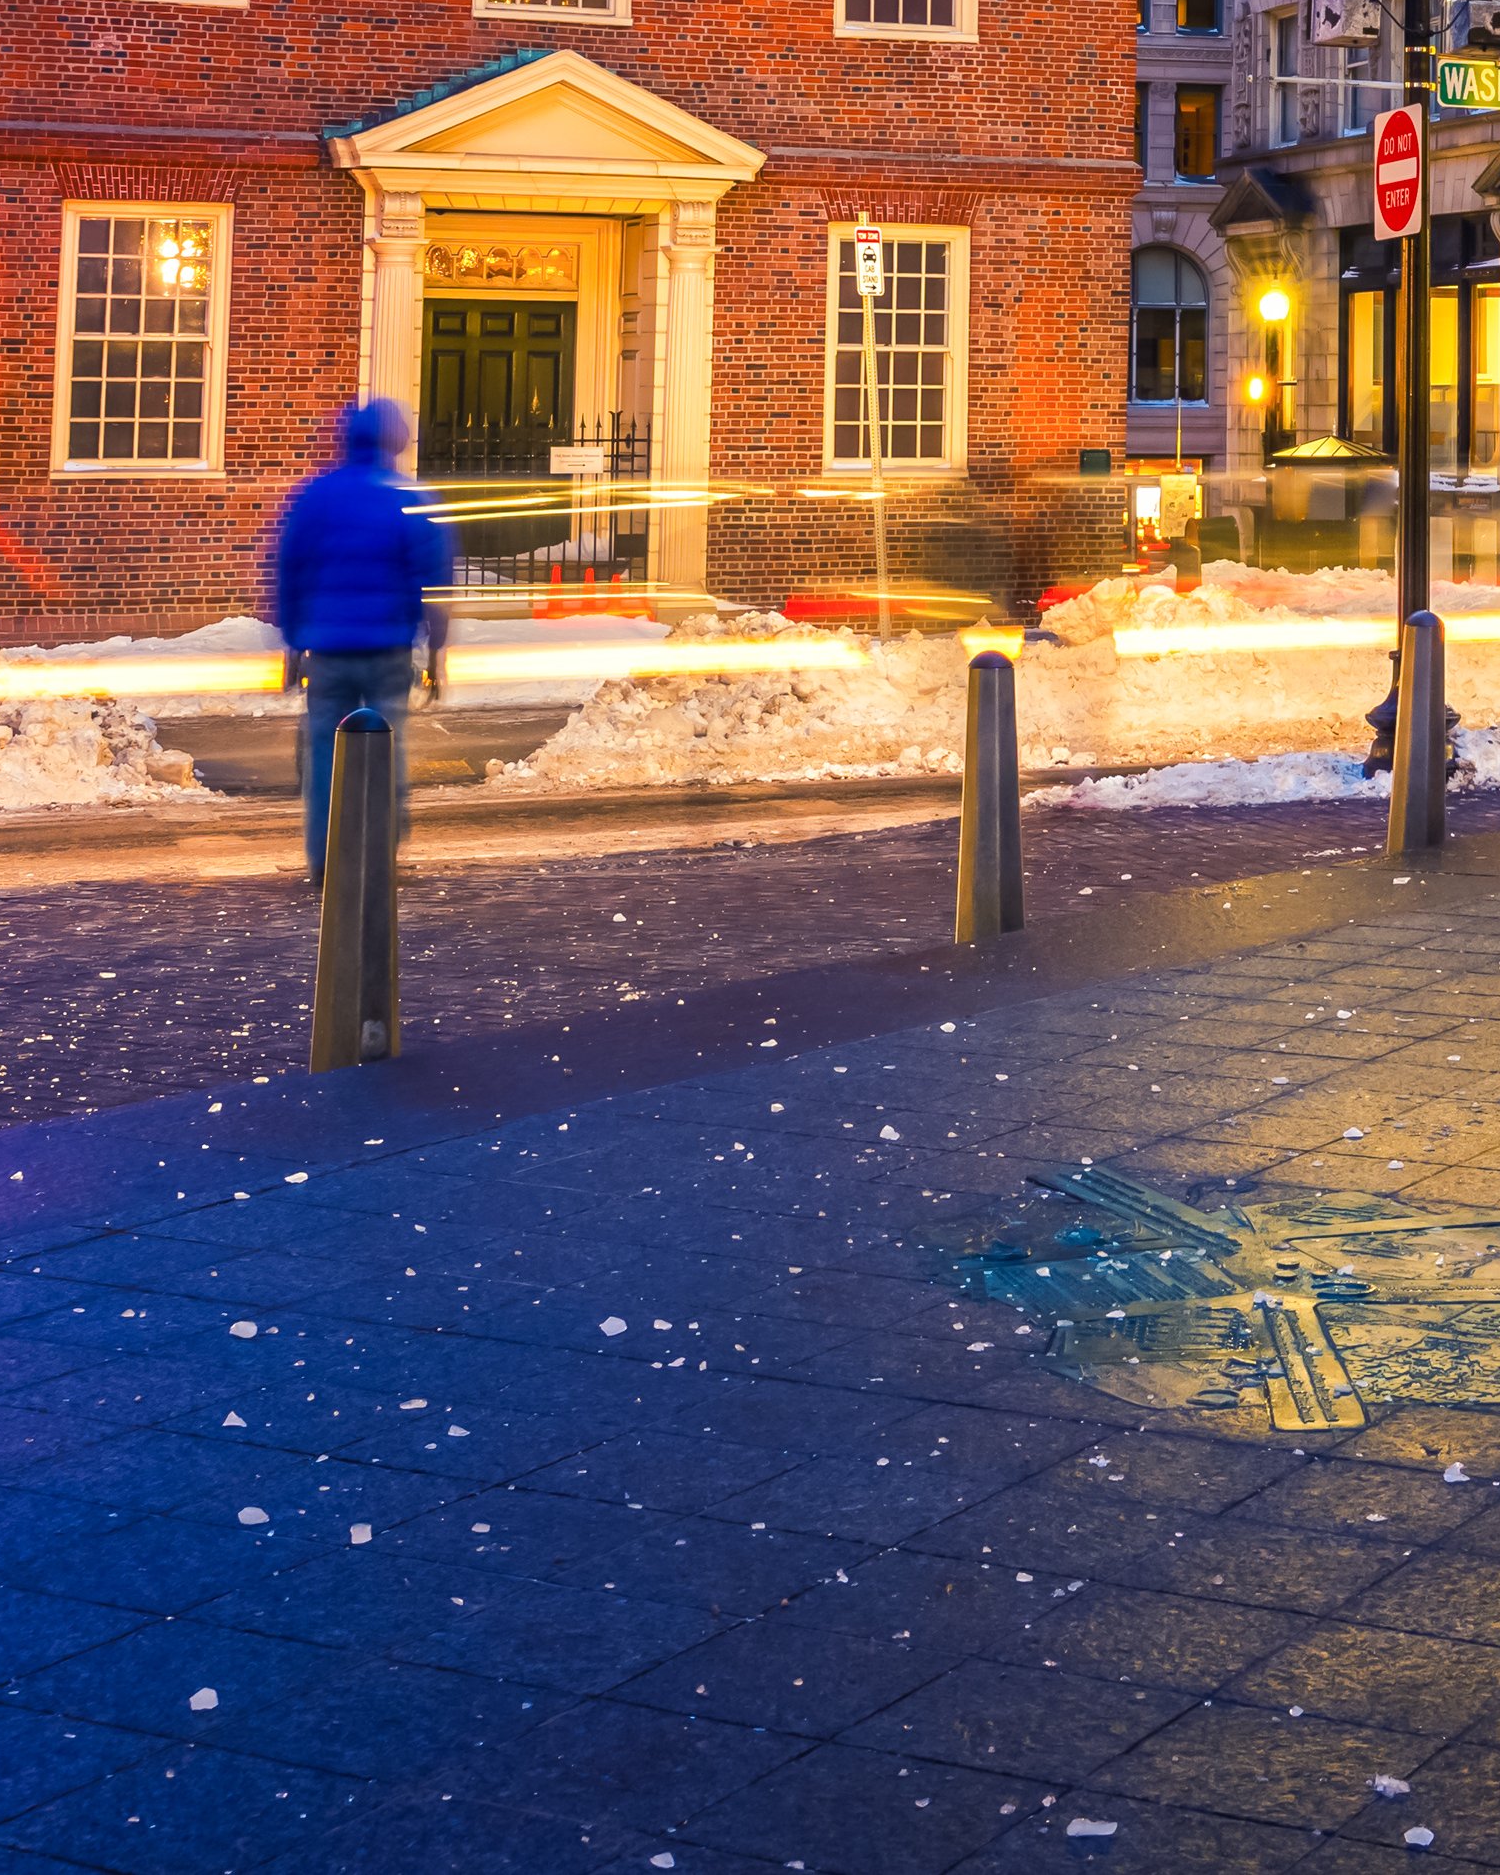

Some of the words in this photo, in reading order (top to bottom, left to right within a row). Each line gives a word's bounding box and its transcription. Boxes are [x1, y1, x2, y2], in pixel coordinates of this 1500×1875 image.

[1384, 135, 1395, 156] DO
[1397, 133, 1412, 153] NOT
[1385, 188, 1410, 209] ENTER
[865, 265, 875, 273] CAB
